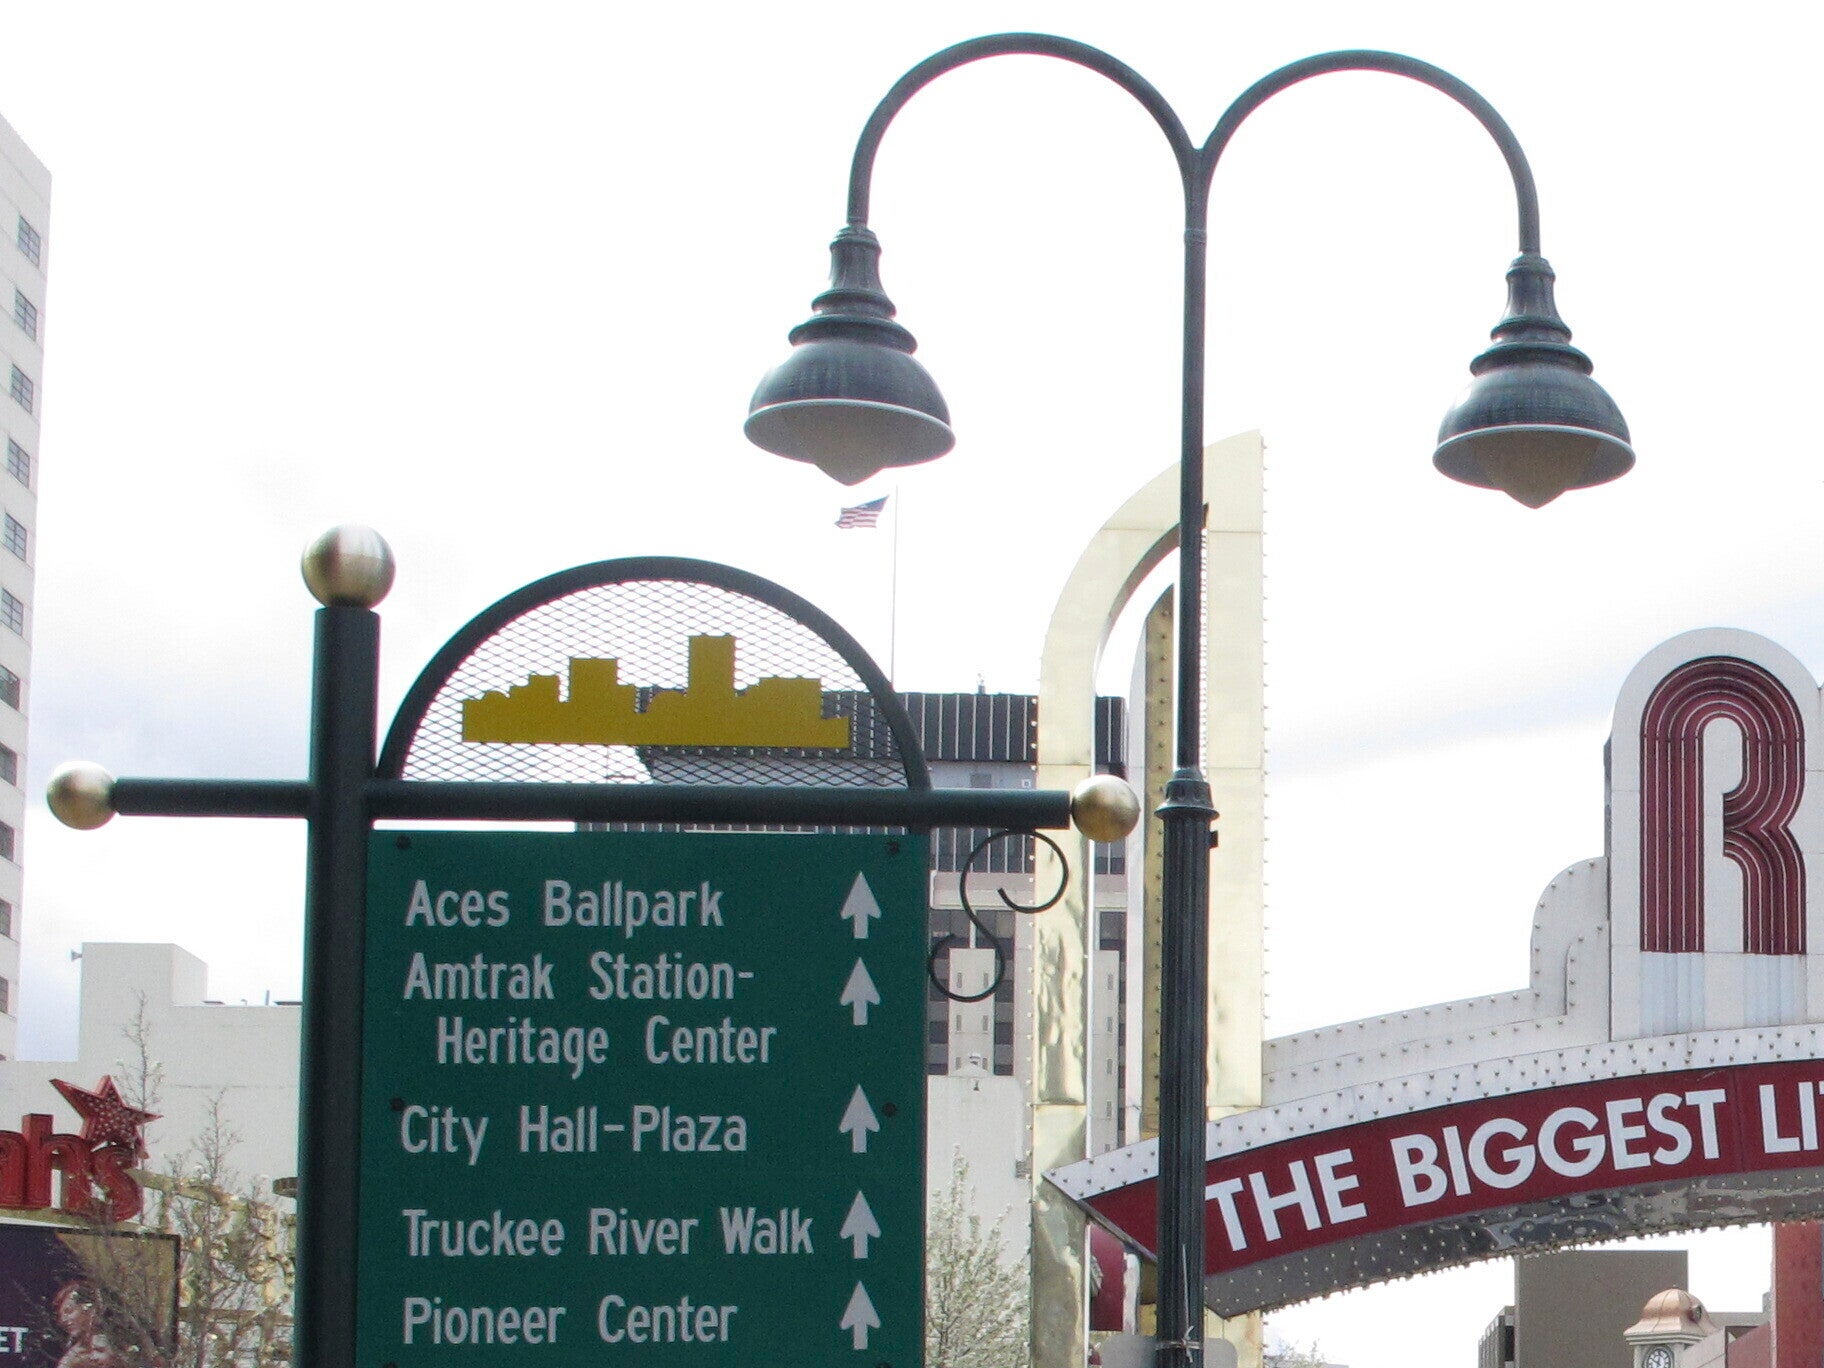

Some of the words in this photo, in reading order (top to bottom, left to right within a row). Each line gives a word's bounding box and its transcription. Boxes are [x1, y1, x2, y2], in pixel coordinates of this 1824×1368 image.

[405, 879, 510, 927] Aces
[544, 880, 724, 938] Ballpark
[403, 952, 554, 1000] Amtrak
[589, 951, 754, 1000] Station-
[437, 1016, 609, 1079] Heritage
[645, 1015, 777, 1064] Center
[400, 1105, 488, 1165] City
[520, 1105, 747, 1153] Hall-Plaza
[1205, 1149, 1367, 1252] THE
[1390, 1089, 1726, 1208] BIGGEST
[403, 1209, 565, 1256] Truckee
[588, 1207, 699, 1255] River
[720, 1206, 814, 1254] Walk
[403, 1297, 566, 1344] Pioneer
[598, 1295, 738, 1343] Center
